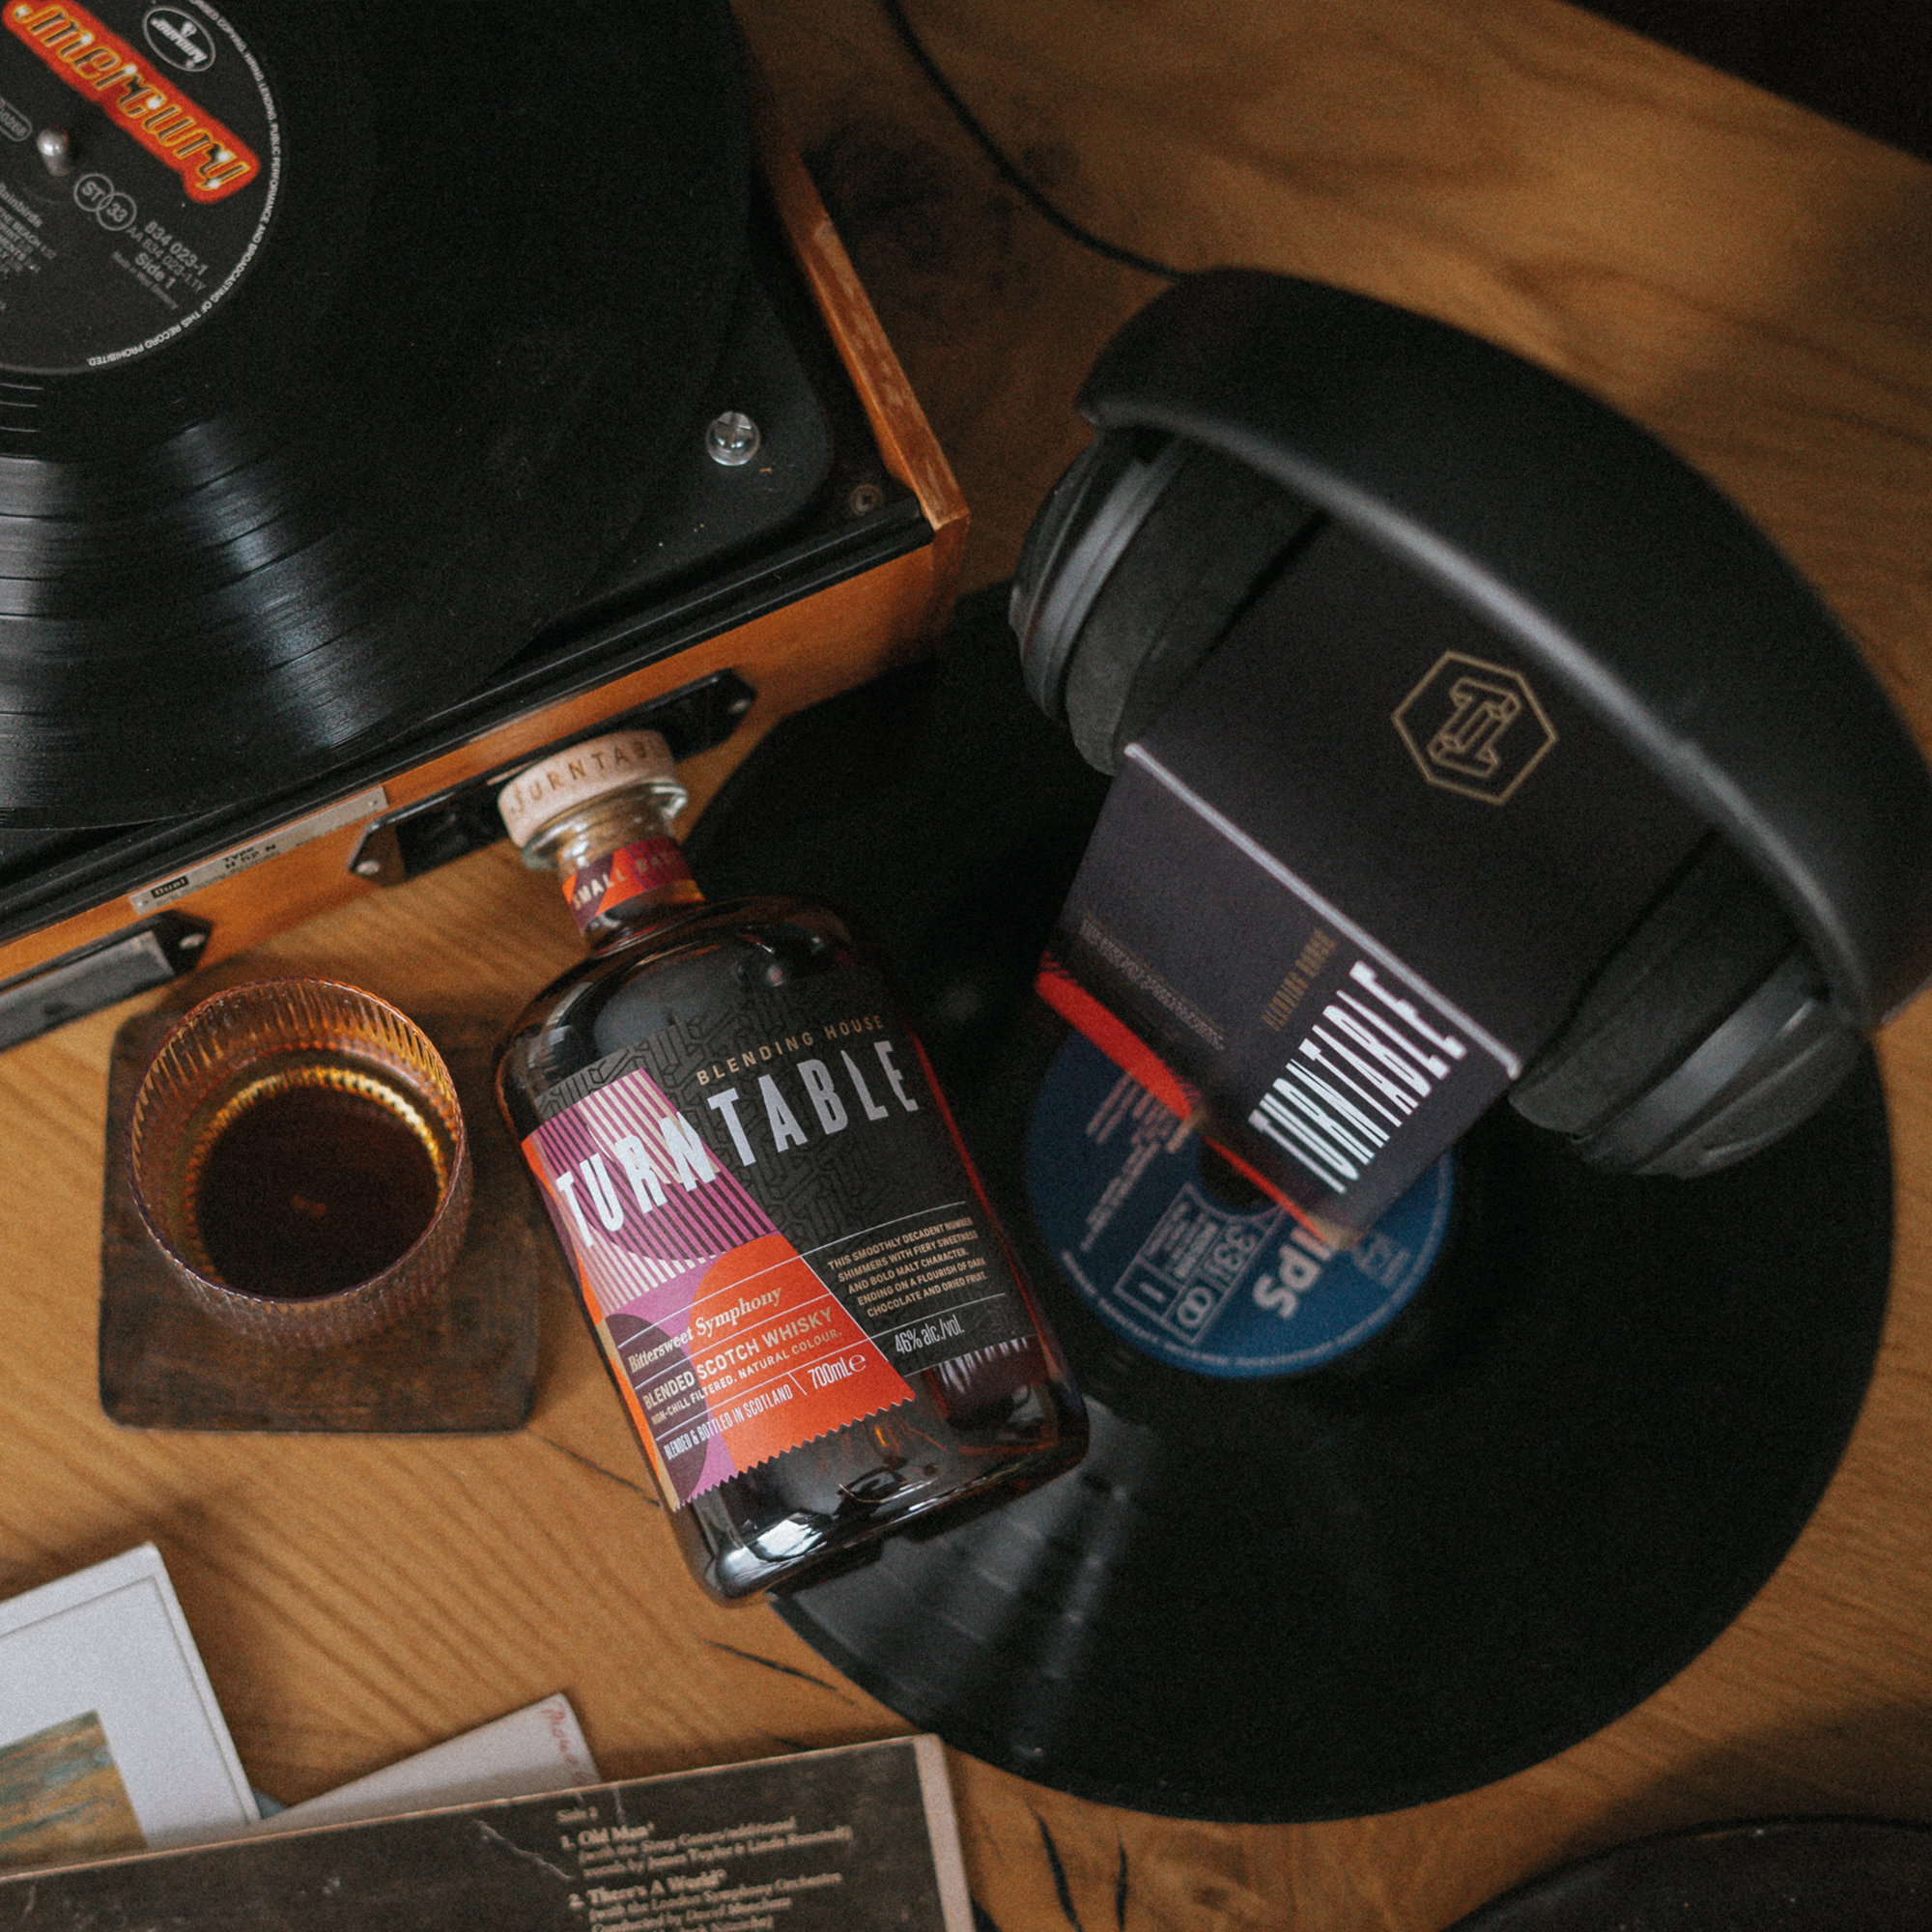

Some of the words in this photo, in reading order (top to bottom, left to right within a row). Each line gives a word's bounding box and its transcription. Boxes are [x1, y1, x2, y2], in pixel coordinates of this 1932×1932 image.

[12, 3, 251, 190] mercury
[82, 181, 105, 202] ST
[106, 203, 128, 222] 33
[260, 156, 281, 224] PERFORMANCE
[145, 221, 172, 246] 834
[170, 242, 209, 275] 023-1
[252, 223, 267, 243] AND
[135, 252, 165, 281] Side
[165, 277, 176, 290] 1
[209, 242, 258, 303] BROADCASTING
[181, 311, 202, 327] THIS
[200, 300, 213, 314] OF
[145, 324, 182, 349] RECORD
[696, 1032, 814, 1086] BLENDING
[824, 1015, 884, 1040] HOUSE
[1248, 960, 1466, 1195] TURNTABLE
[556, 1040, 919, 1248] TURNTABLE
[828, 1257, 852, 1271] THIS
[853, 1236, 903, 1262] SMOOTHLY
[902, 1223, 946, 1244] DECADENT
[838, 1257, 889, 1282] SHIMMERS
[889, 1250, 914, 1263] WITH
[913, 1243, 938, 1257] FIERY
[937, 1230, 979, 1248] SWEETNESS
[848, 1281, 869, 1294] AND
[869, 1269, 895, 1286] BOLD
[895, 1261, 922, 1276] MALT
[857, 1287, 894, 1306] ENDING
[895, 1280, 909, 1292] ON
[910, 1277, 918, 1287] A
[917, 1264, 958, 1284] FLOURISH
[957, 1261, 968, 1271] OF
[967, 1257, 987, 1269] DARK
[867, 1290, 923, 1318] CHOCOLATE
[923, 1284, 942, 1298] AND
[941, 1277, 966, 1292] DRIED
[966, 1271, 988, 1286] FRUIT.
[628, 1327, 695, 1374] Bittersweet
[696, 1288, 782, 1337] Symphony
[895, 1328, 923, 1354] 46%
[921, 1314, 966, 1346] alc./vol.
[643, 1370, 696, 1410] BLENDED
[696, 1338, 760, 1380] SCOTCH
[761, 1306, 833, 1349] WHISKY
[651, 1398, 691, 1425] NON-CHILL
[691, 1376, 738, 1404] FILTERED.
[739, 1350, 790, 1378] NATURAL
[790, 1328, 842, 1355] COLOUR.
[664, 1432, 693, 1462] BLENDED
[691, 1428, 700, 1444] &
[697, 1412, 734, 1439] BOTTLED
[731, 1406, 745, 1424] IN
[743, 1383, 794, 1418] SCOTLAND
[578, 1827, 611, 1848] Old
[568, 1893, 584, 1909] 2.
[650, 1880, 666, 1895] A
